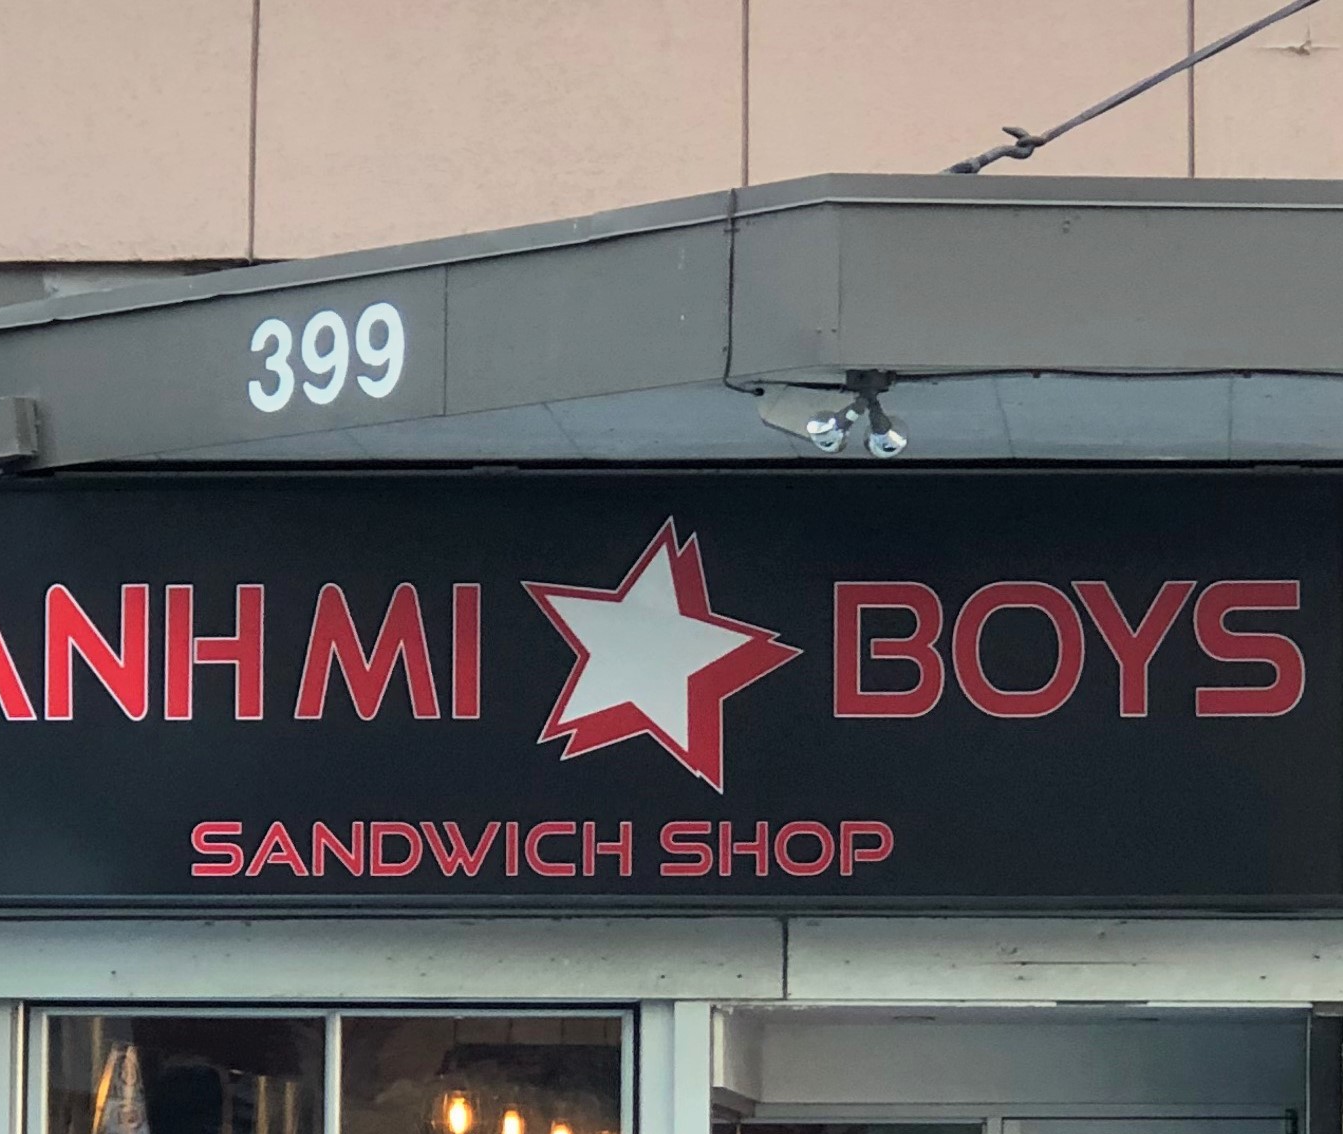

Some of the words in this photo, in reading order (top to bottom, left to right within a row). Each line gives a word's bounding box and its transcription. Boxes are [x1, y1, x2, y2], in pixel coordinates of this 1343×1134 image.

[248, 302, 405, 413] 399
[293, 582, 482, 721] MI
[833, 579, 1307, 719] BOYS
[190, 821, 633, 878] SANDWICH
[659, 820, 895, 878] SHOP
